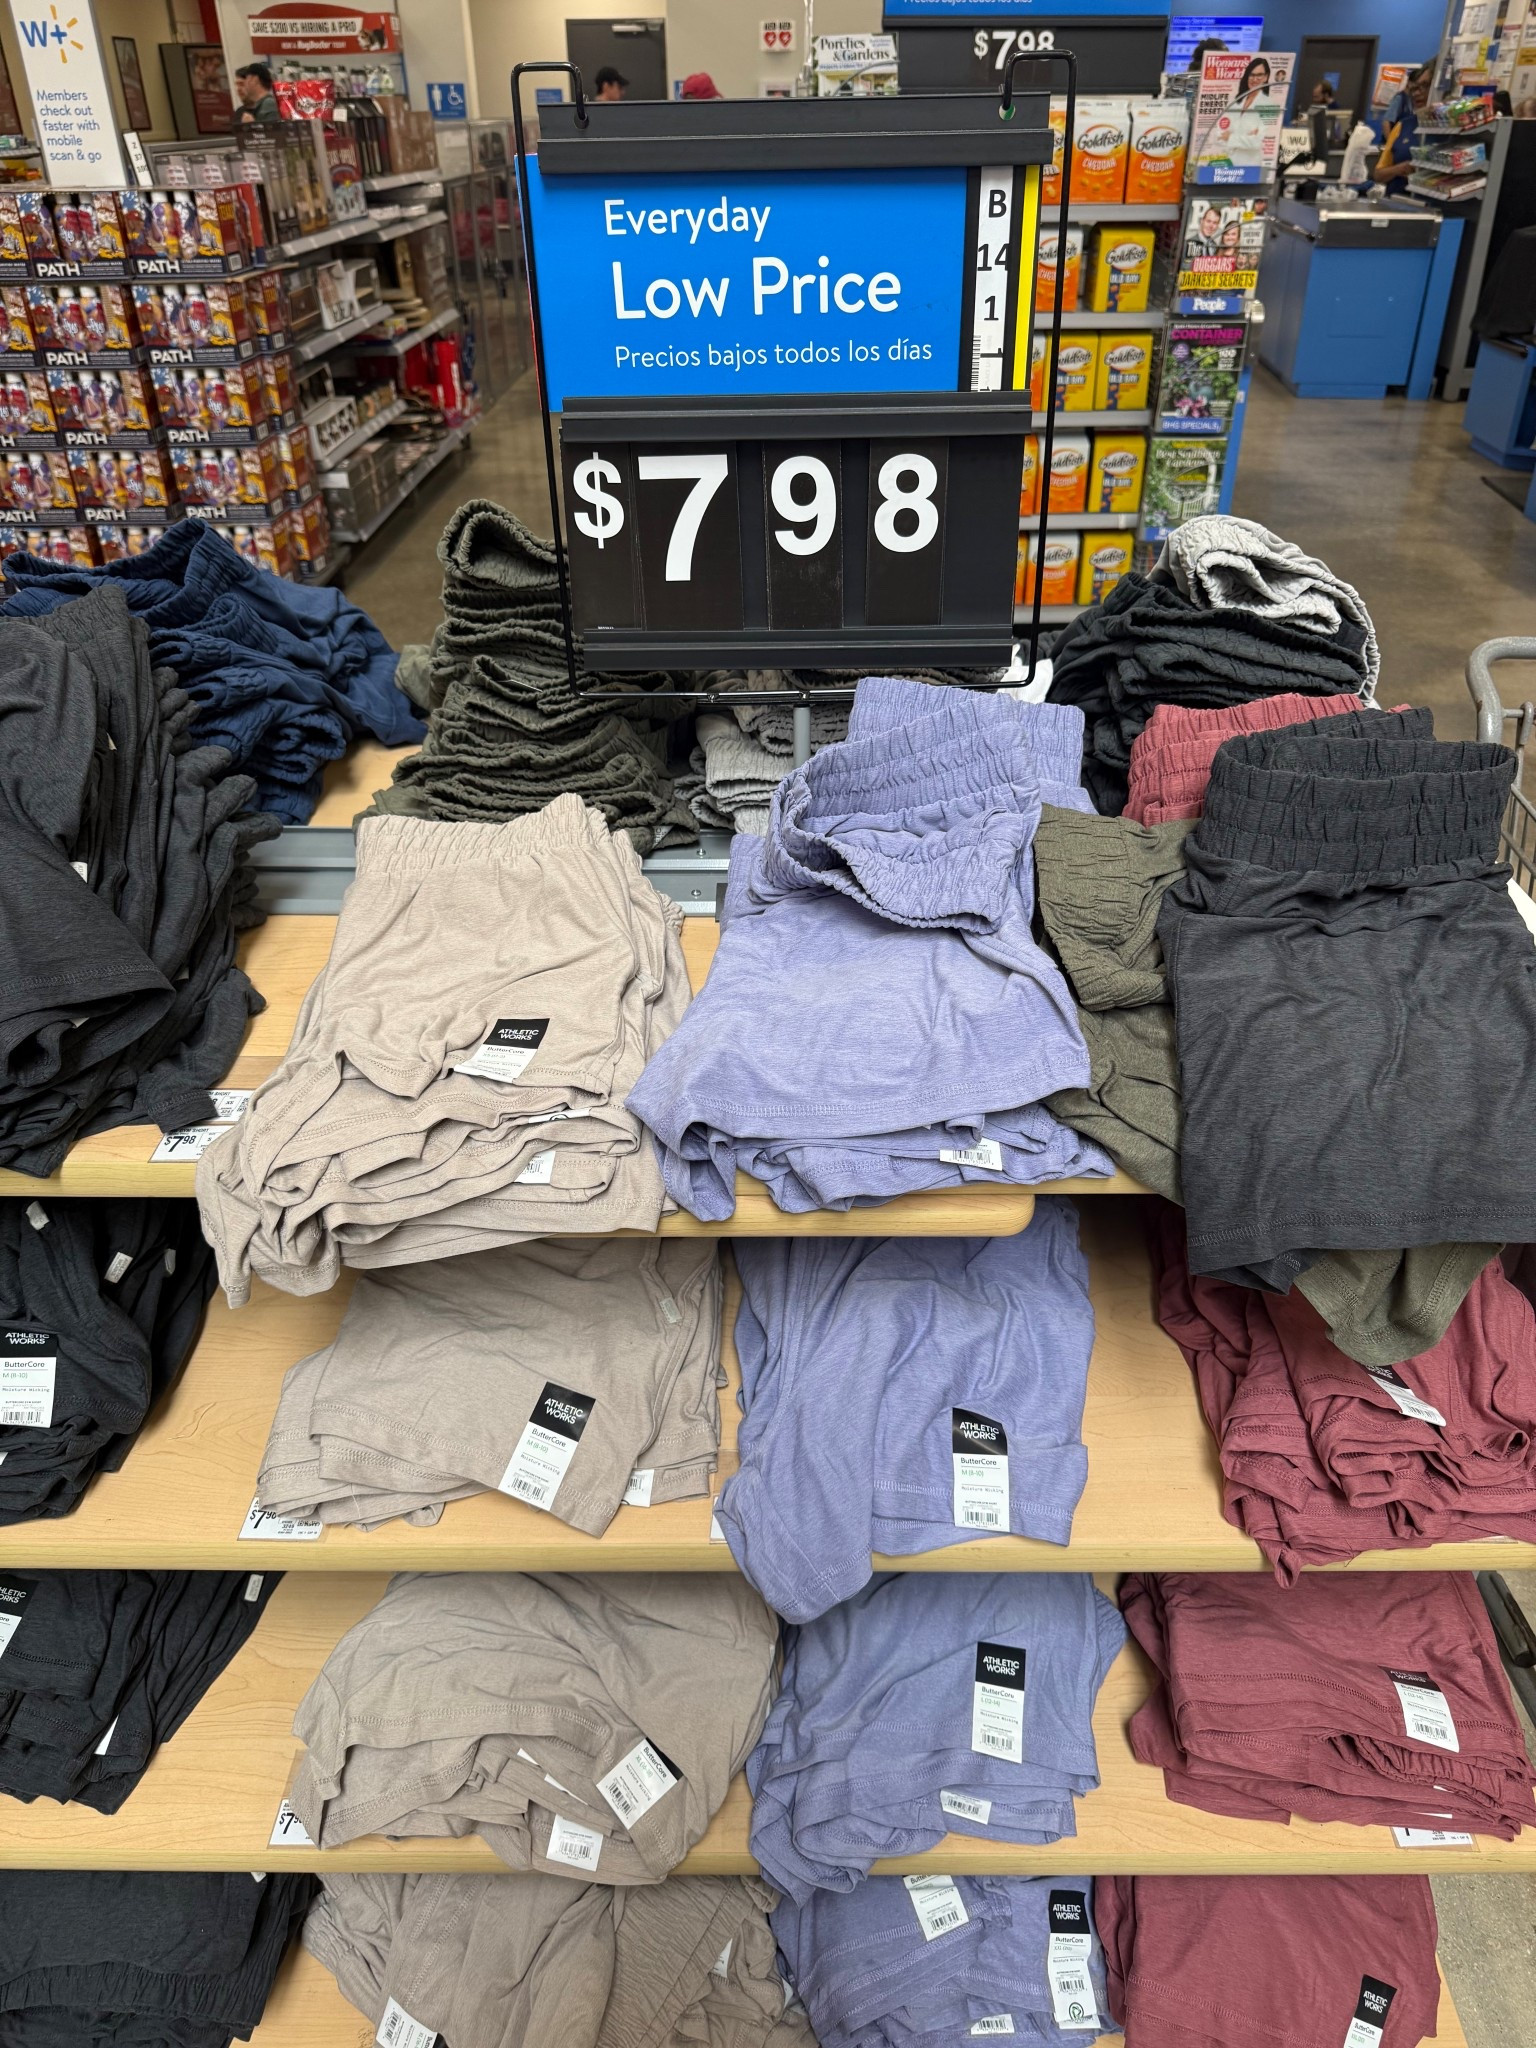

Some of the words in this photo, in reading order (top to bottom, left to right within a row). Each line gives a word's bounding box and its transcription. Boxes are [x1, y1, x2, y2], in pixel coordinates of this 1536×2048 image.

[339, 20, 356, 33] PRO
[820, 37, 865, 50] Porches
[1207, 56, 1250, 67] Woman's
[37, 90, 88, 101] Members
[40, 104, 71, 116] check
[75, 105, 93, 116] out
[43, 119, 74, 131] faster
[78, 119, 100, 131] with
[47, 134, 83, 146] mobile
[1077, 128, 1124, 151] Goldfish
[1136, 130, 1182, 153] Goldfish
[50, 152, 74, 161] scan
[77, 149, 85, 161] &
[88, 152, 102, 163] go
[988, 189, 1008, 218] B
[604, 196, 770, 244] Everyday
[1187, 241, 1203, 256] The
[977, 243, 1009, 271] 14
[37, 263, 80, 277] PATH
[138, 260, 180, 274] PATH
[1218, 273, 1255, 287] SECRETS
[612, 261, 730, 320] Low
[752, 255, 902, 315] Price
[984, 296, 999, 320] 1
[1193, 298, 1227, 313] People
[1171, 329, 1242, 340] CONTAINER
[46, 352, 89, 366] PATH
[151, 350, 194, 363] PATH
[615, 346, 701, 368] Precios
[708, 344, 768, 372] bajos
[774, 341, 840, 364] todos
[849, 340, 880, 362] los
[888, 338, 932, 361] días
[65, 431, 108, 445] PATH
[168, 429, 209, 443] PATH
[85, 508, 126, 521] PATH
[186, 506, 227, 518] PATH
[487, 1046, 525, 1054] ButterCore
[545, 1398, 583, 1417] ATHLETIC
[546, 1407, 577, 1425] WORKS
[960, 1421, 999, 1434] ATHLETIC
[532, 1428, 566, 1448] ButterCore
[963, 1430, 996, 1441] WORKS
[960, 1457, 997, 1465] ButterCore
[983, 1656, 1019, 1669] ATHLETIC
[986, 1663, 1016, 1676] WORKS
[981, 1686, 1014, 1698] ButterCore
[643, 1746, 667, 1778] ButterCore
[1053, 1904, 1081, 1912] ATHLETIC
[1055, 1912, 1080, 1920] WORKS
[1363, 1990, 1388, 2007] ATHLETIC
[1364, 1999, 1384, 2014] WORKS
[1354, 2022, 1375, 2035] ButterCore
